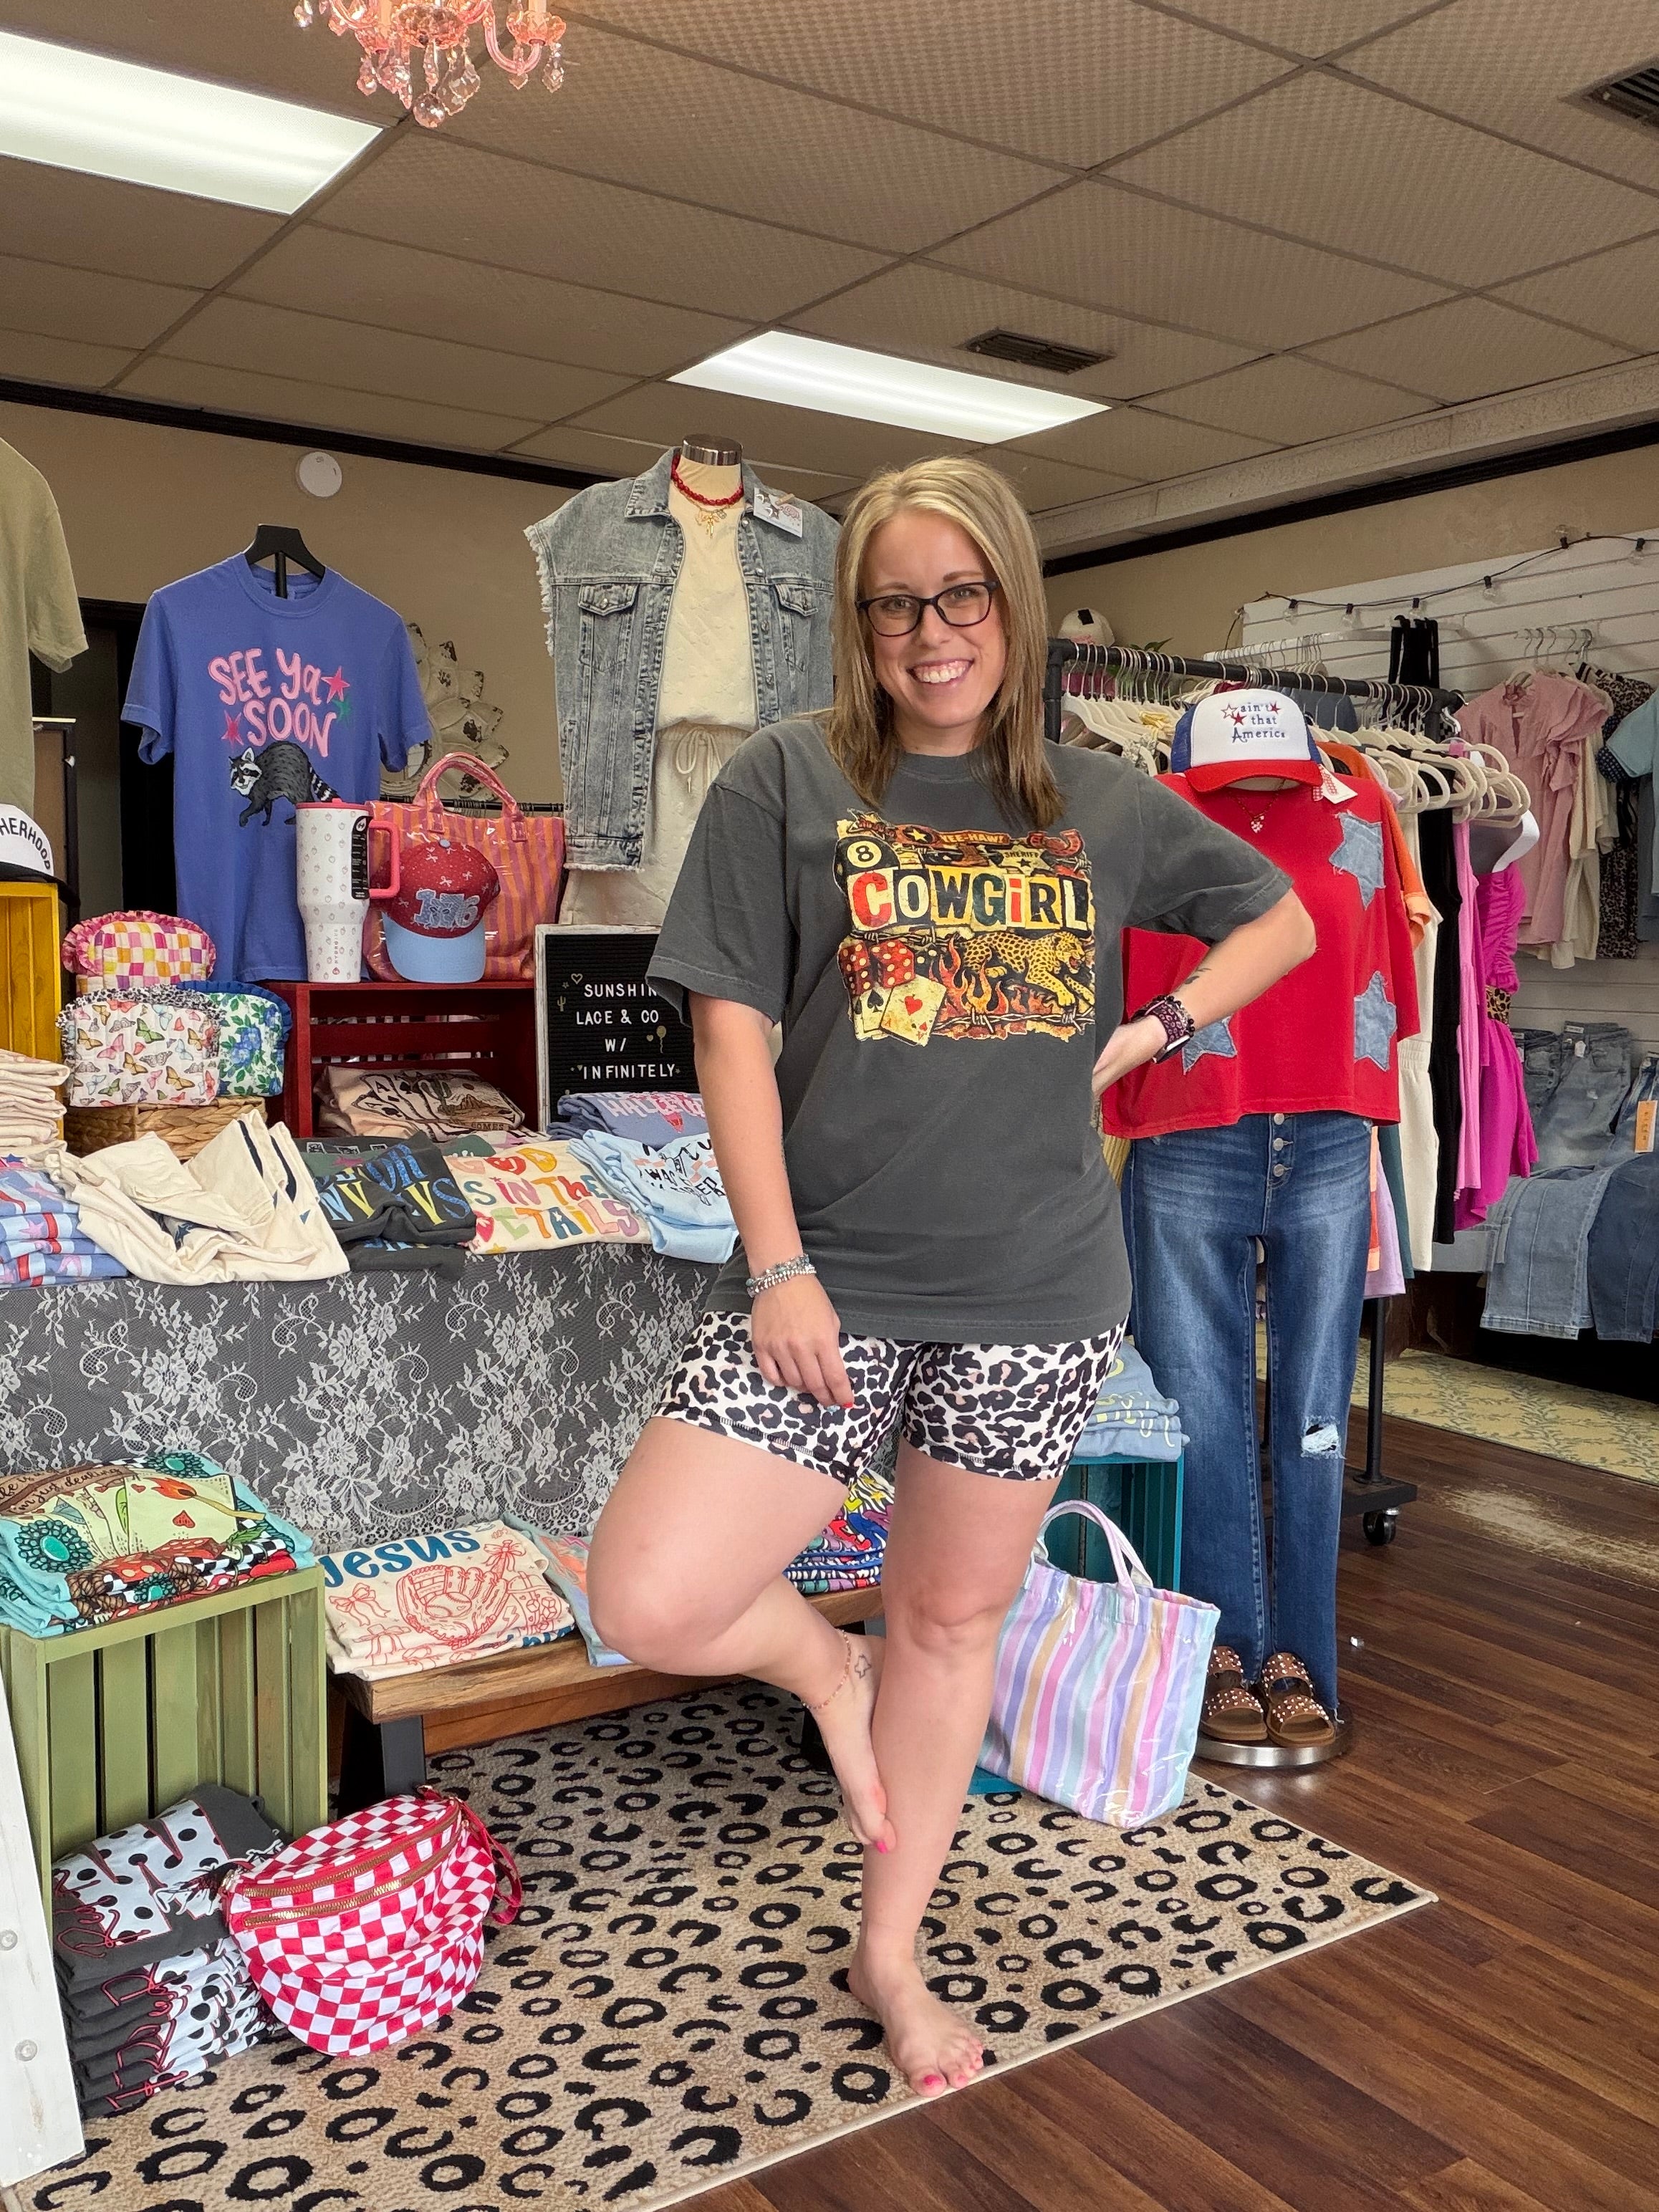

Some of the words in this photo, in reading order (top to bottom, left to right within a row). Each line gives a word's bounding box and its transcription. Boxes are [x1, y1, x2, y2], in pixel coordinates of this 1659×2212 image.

[208, 648, 271, 705] SEE
[243, 698, 337, 757] SOON
[1251, 713, 1278, 725] that
[1232, 727, 1286, 744] America
[0, 817, 51, 870] HERHOOD
[855, 845, 874, 862] 8
[576, 1010, 614, 1026] LACE
[620, 1009, 633, 1025] &
[640, 1009, 659, 1024] CO
[583, 1063, 675, 1079] INFINITELY
